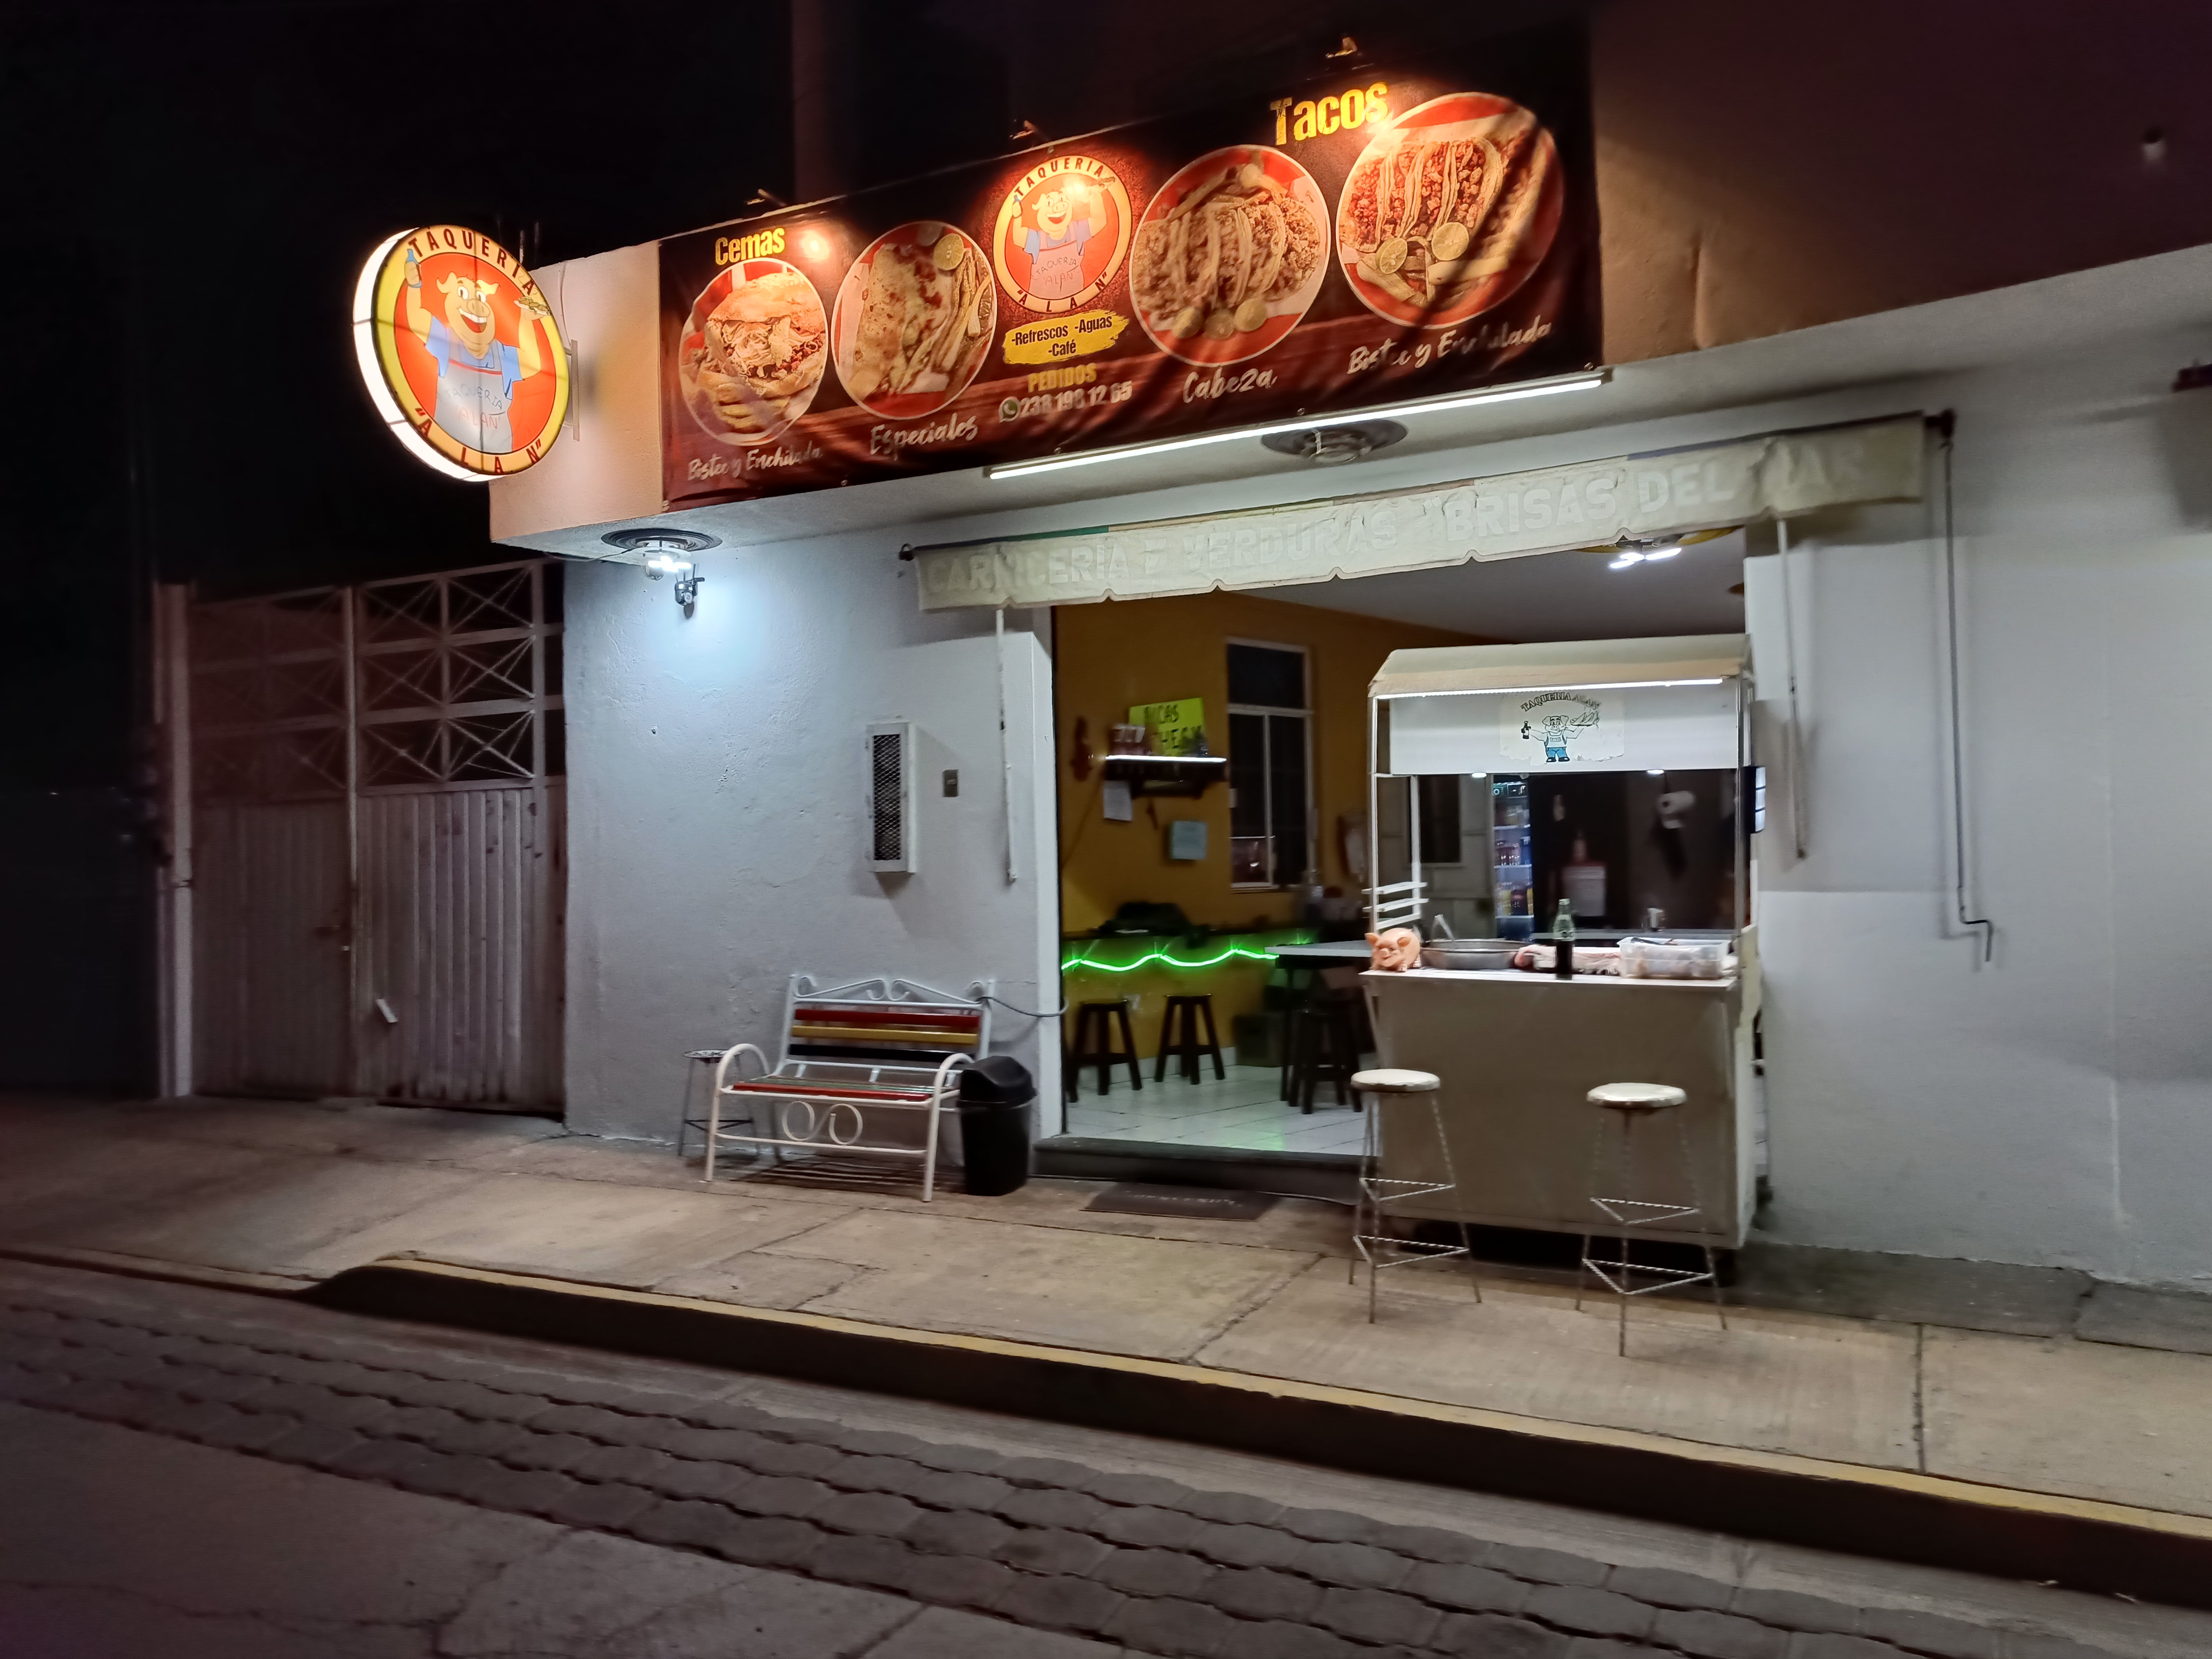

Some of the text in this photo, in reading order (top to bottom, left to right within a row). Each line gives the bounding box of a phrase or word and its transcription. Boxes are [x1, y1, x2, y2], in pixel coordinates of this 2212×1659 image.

[1270, 81, 1389, 145] Tacos
[1015, 157, 1104, 198] TAQUERIA
[408, 228, 536, 296] TAQUERIA
[715, 227, 785, 265] Cemas
[1415, 343, 1432, 368] y
[1087, 385, 1108, 407] 12
[870, 412, 978, 461] Especiales
[730, 458, 742, 478] y
[1183, 511, 1397, 570] VERDURAS
[1637, 459, 1737, 513] DEL
[1520, 692, 1572, 712] TAQUERIA
